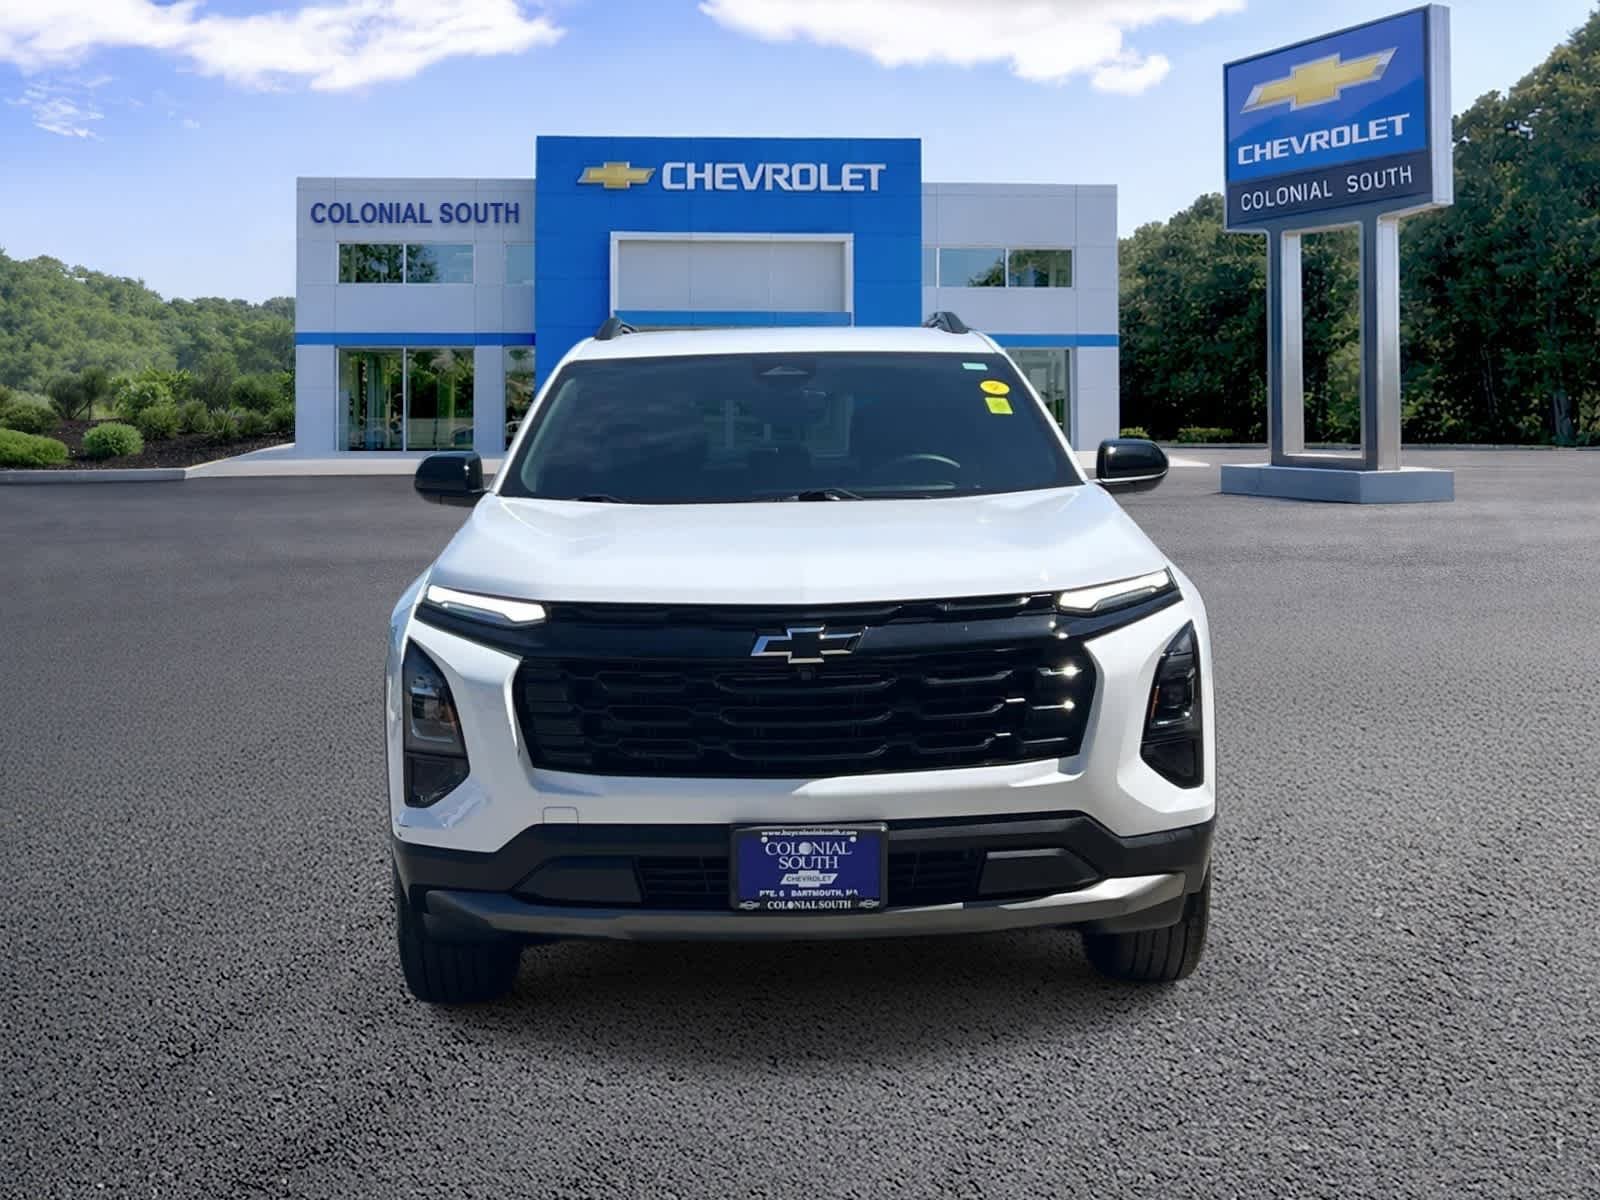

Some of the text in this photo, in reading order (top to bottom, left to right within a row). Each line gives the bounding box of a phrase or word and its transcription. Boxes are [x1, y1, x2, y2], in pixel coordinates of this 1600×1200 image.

[1237, 113, 1410, 165] CHEVROLET
[662, 161, 886, 191] CHEVROLET
[1240, 165, 1413, 211] COLONIAL SOUTH
[310, 202, 520, 224] COLONIAL SOUTH
[765, 841, 853, 856] COLONIAL
[778, 856, 838, 869] SOUTH
[779, 889, 785, 897] 6
[767, 900, 851, 909] COLONIAL SOUTH
